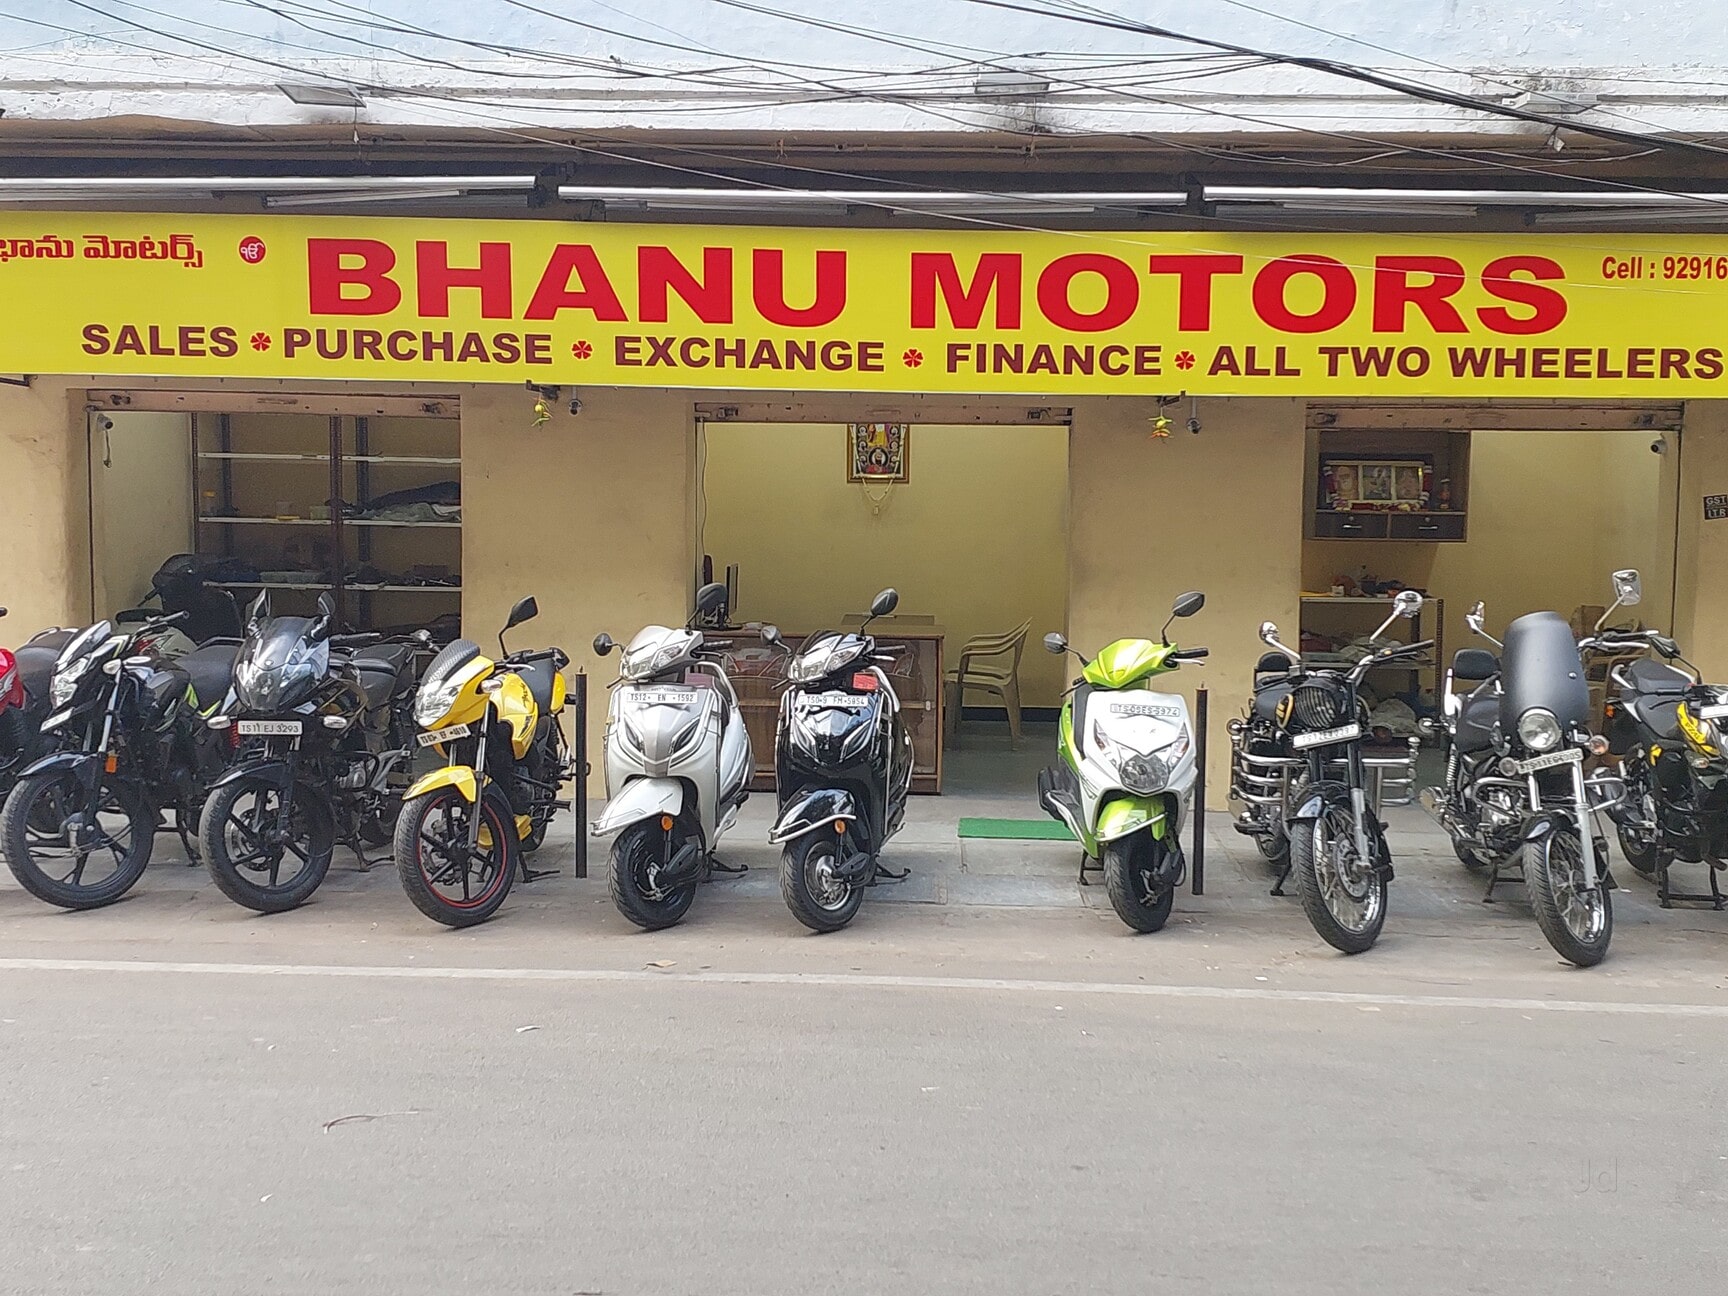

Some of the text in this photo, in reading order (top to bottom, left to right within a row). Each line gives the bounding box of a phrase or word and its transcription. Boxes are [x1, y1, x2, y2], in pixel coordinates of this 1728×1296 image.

[1602, 256, 1643, 279] Cell
[307, 237, 1568, 336] BHANU MOTORS
[81, 324, 1725, 380] SALES PURCHASE EXCHANGE FINANCE ALL TWO WHEELERS
[630, 693, 694, 702] TS12 EN 1592
[276, 724, 299, 733] 3293
